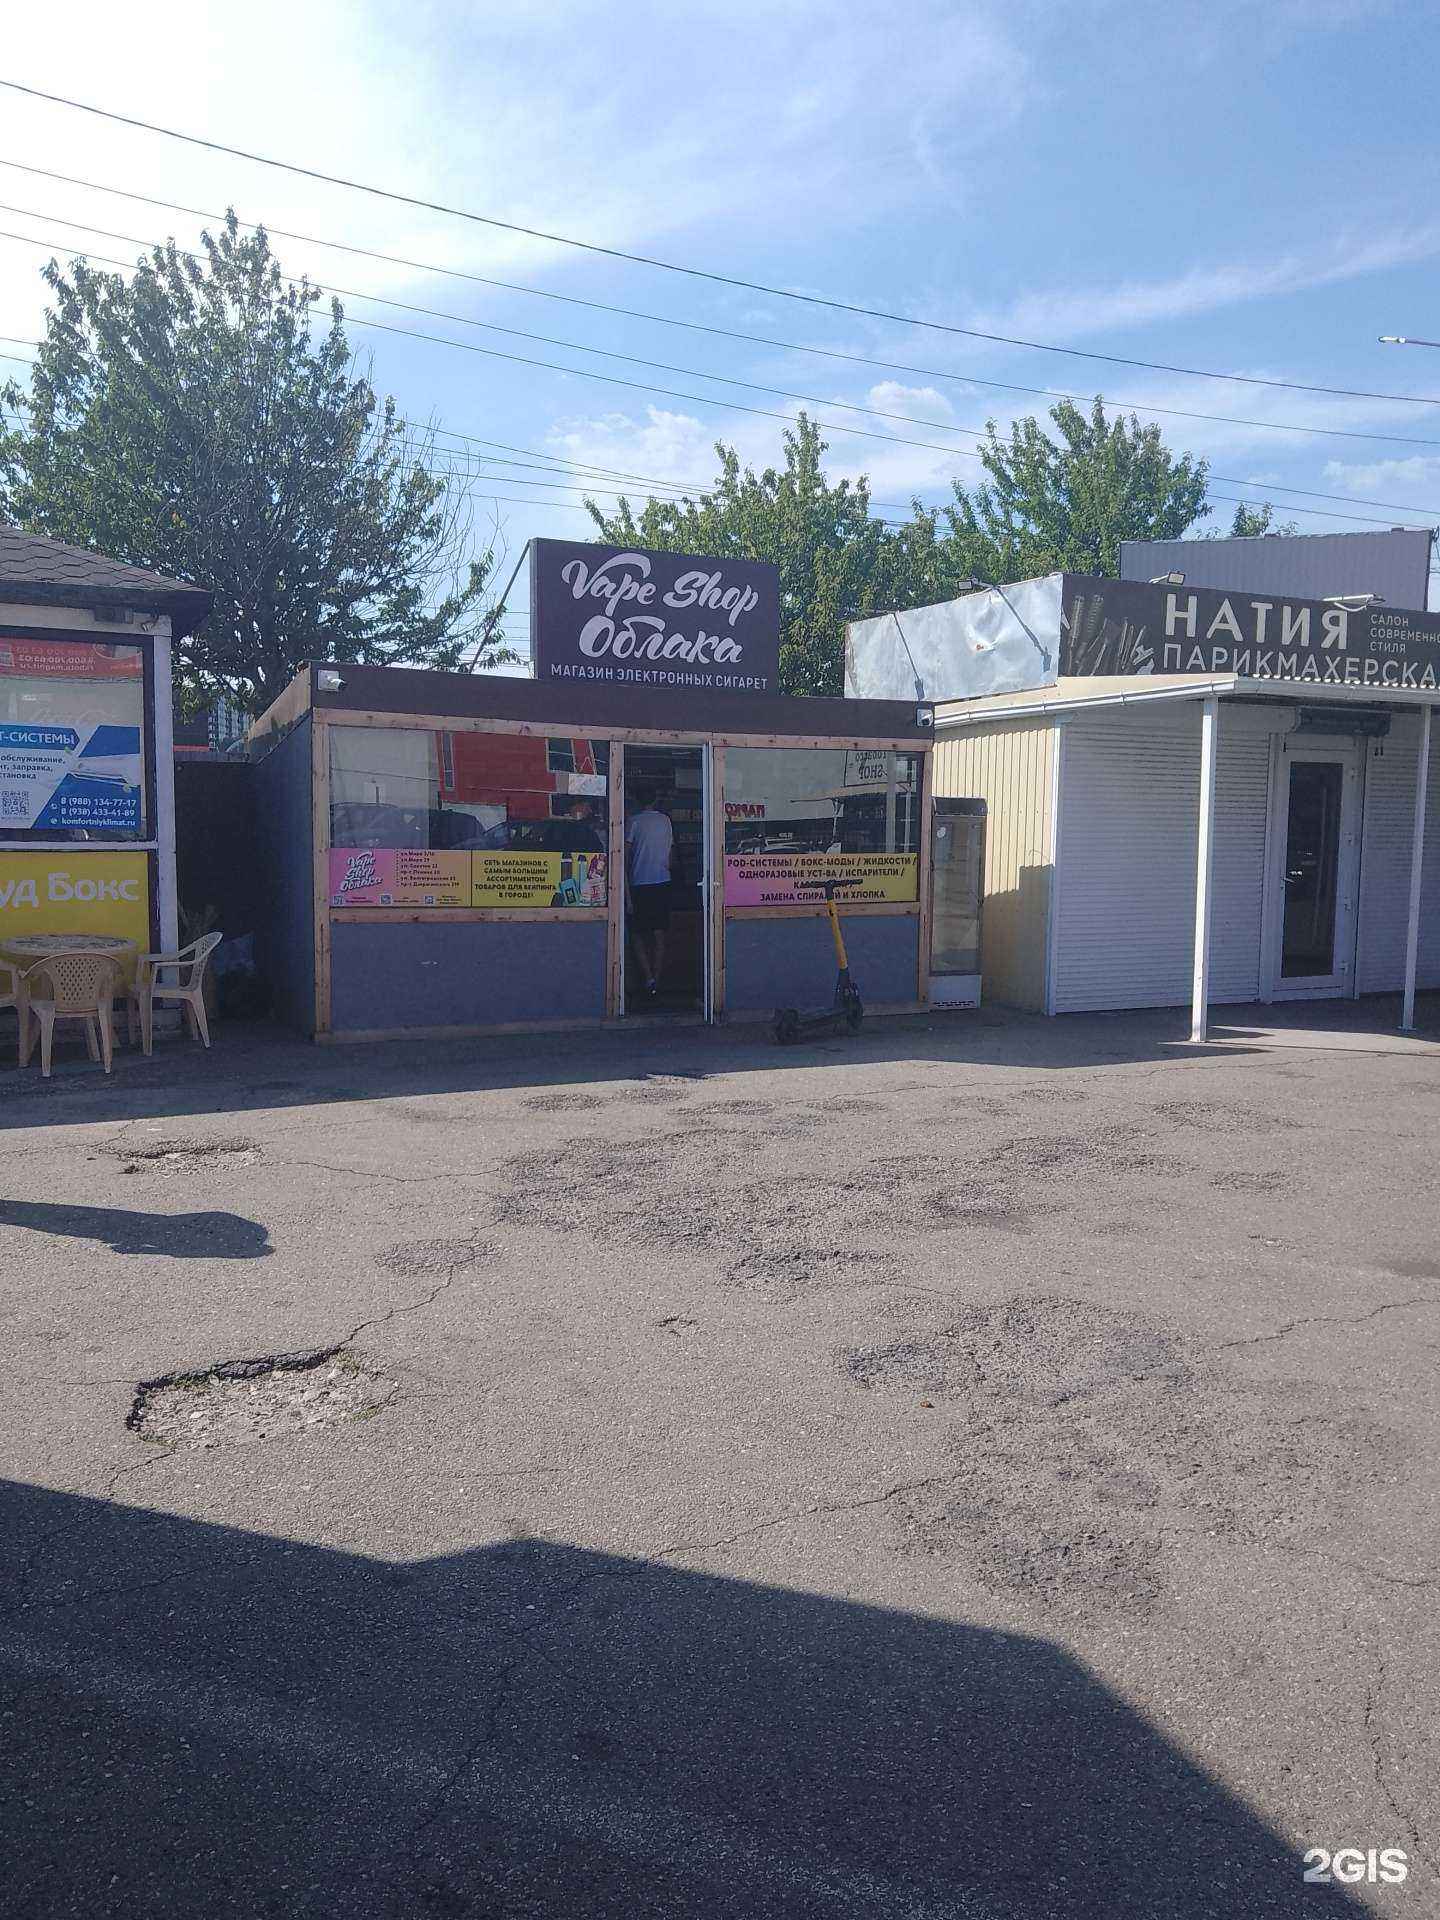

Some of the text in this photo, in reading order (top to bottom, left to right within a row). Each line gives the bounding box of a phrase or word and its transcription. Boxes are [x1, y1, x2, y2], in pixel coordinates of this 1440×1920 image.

[561, 552, 759, 626] Vape Shop
[1165, 593, 1348, 650] НАТИЯ
[1370, 614, 1409, 627] САЛОН
[578, 615, 743, 664] Облака
[1370, 641, 1406, 653] СТИЛЯ
[1164, 643, 1437, 687] ПАРИКМАХЕРСКА
[551, 663, 768, 690] МАГАЗИН ЭЛЕКТРОННЫХ СИГАРЕТ
[60, 797, 67, 805] 8
[61, 807, 67, 815] 8
[728, 858, 792, 867] POD-СИСТЕМЫ
[801, 858, 855, 866] БОКС-МОДЫ
[864, 857, 912, 865] ЖИДКОСТИ
[738, 869, 805, 879] ОДНОРАЗОВЫЕ
[807, 868, 837, 878] УСТ-ВА
[846, 867, 898, 877] ИСПАРИТЕЛИ
[48, 872, 139, 901] Бокс
[760, 892, 795, 901] ЗАМЕНА
[797, 890, 842, 901] СПИРАЙ
[850, 890, 885, 899] ХЛОПКА
